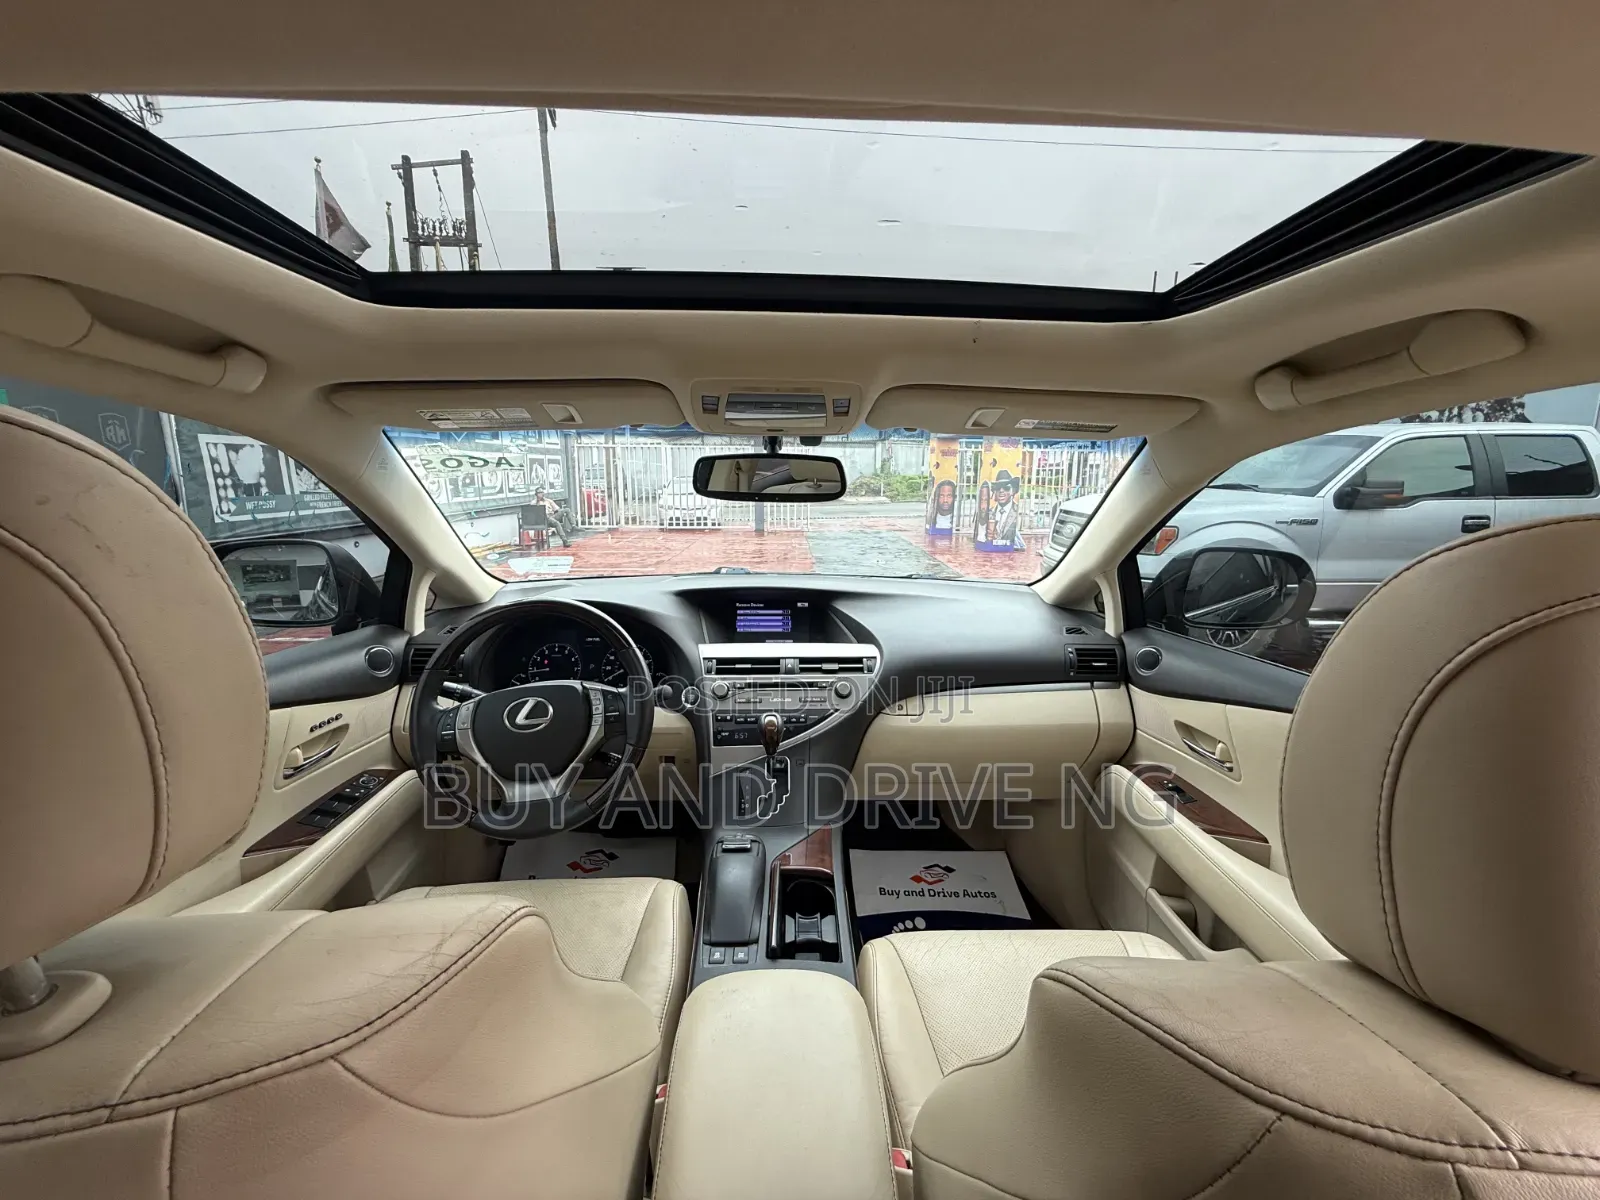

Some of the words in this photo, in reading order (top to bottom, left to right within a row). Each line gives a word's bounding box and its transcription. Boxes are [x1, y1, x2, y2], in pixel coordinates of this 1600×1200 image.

[878, 887, 901, 898] Buy
[903, 888, 925, 897] and
[928, 888, 960, 898] Drive
[962, 889, 997, 899] Autos
